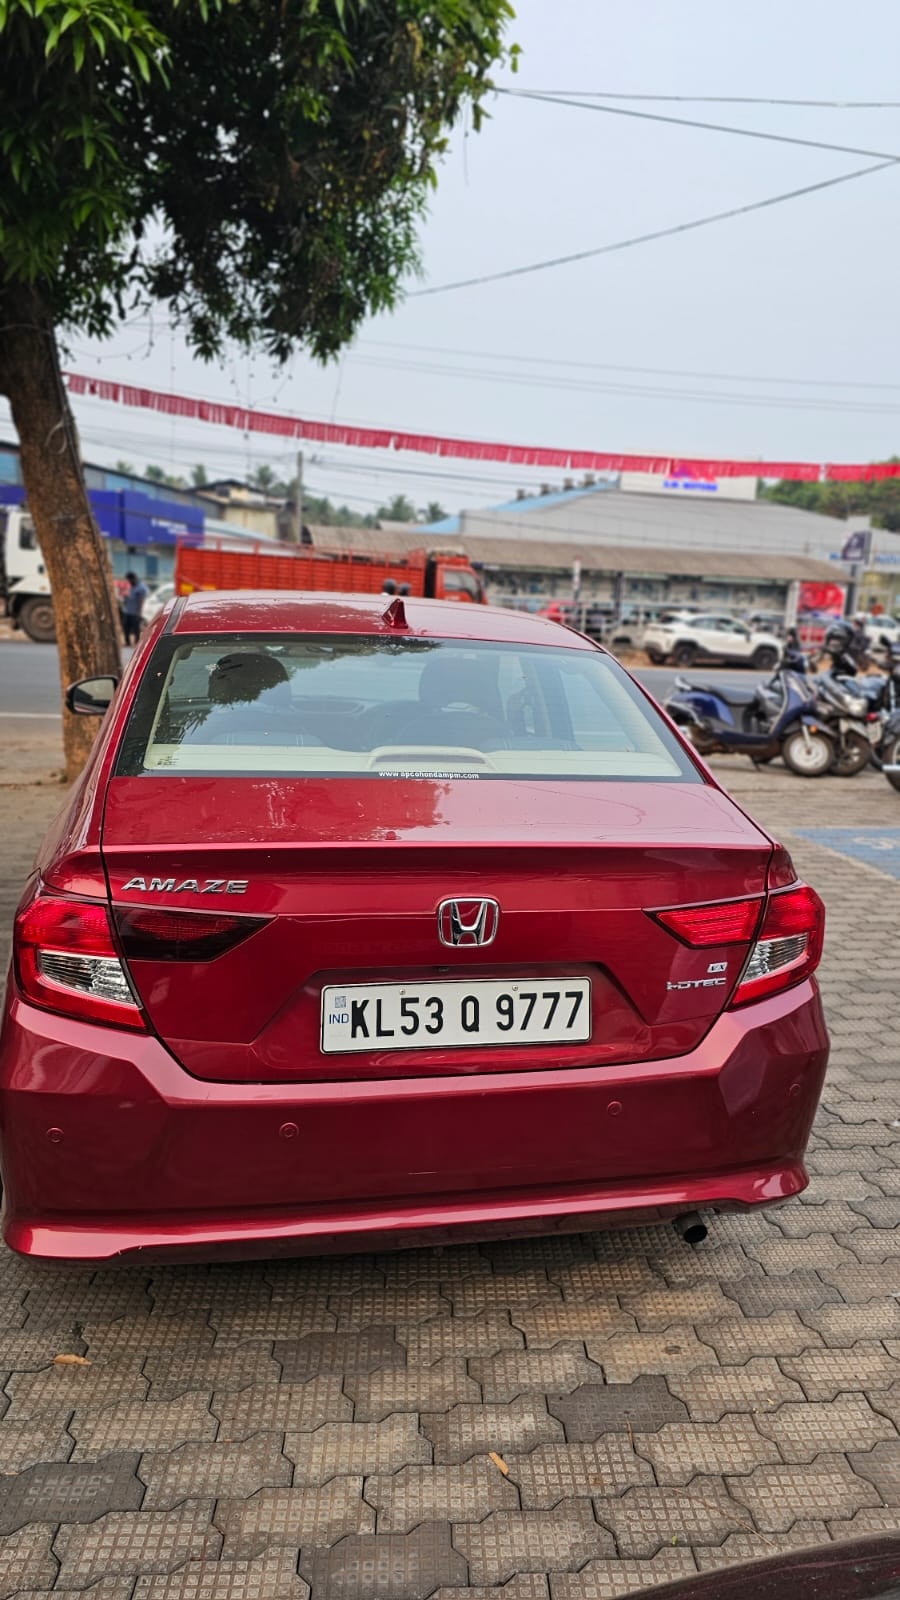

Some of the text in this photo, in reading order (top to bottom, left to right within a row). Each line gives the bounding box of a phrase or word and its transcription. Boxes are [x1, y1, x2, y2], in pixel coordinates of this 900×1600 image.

[121, 877, 249, 894] AMAZE
[329, 1013, 350, 1025] IND
[351, 991, 584, 1039] KL53 Q 9777
